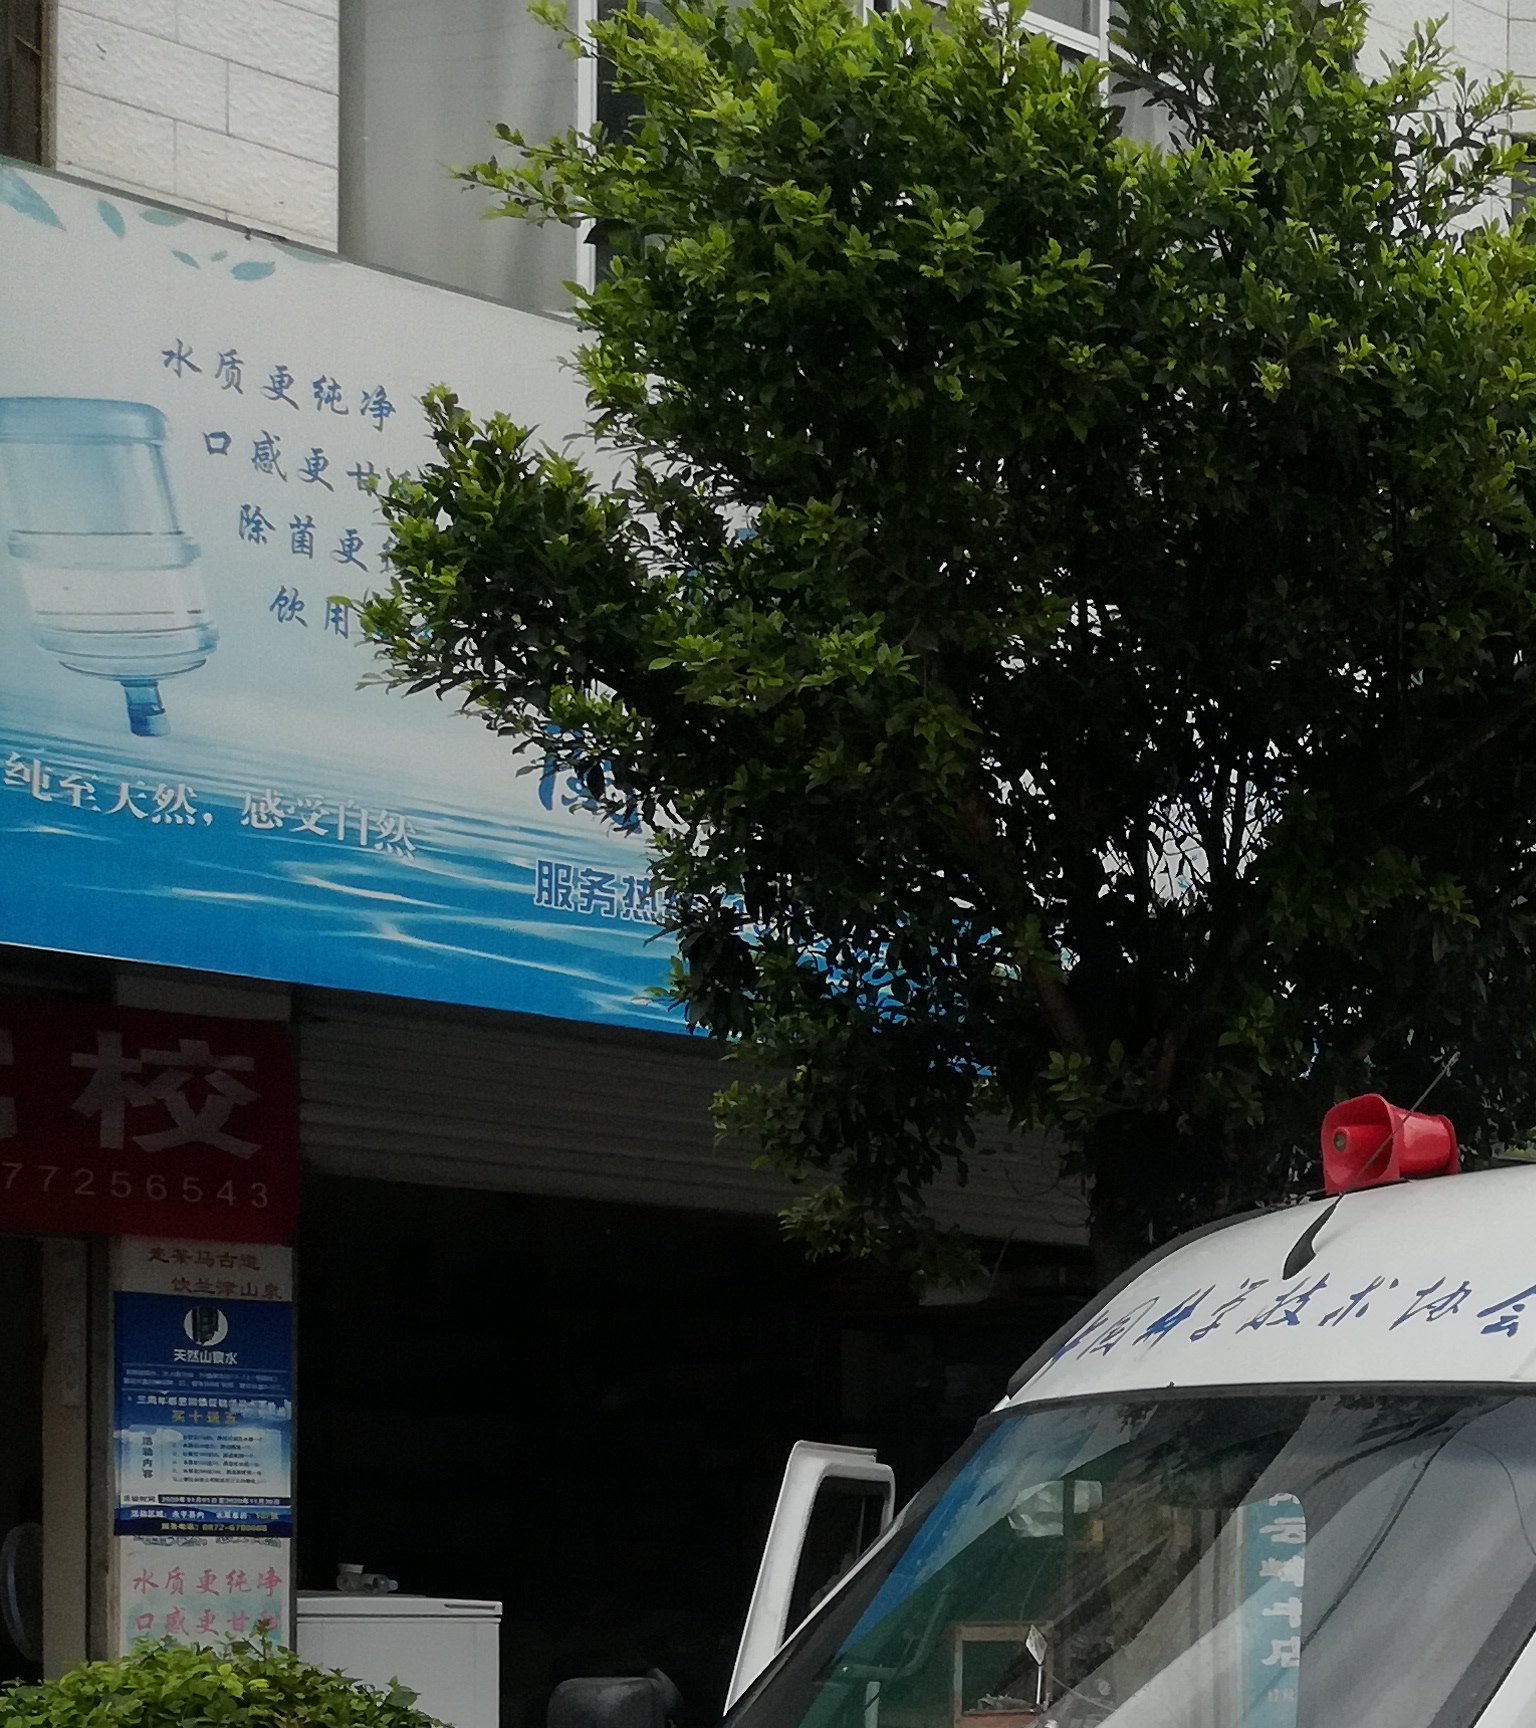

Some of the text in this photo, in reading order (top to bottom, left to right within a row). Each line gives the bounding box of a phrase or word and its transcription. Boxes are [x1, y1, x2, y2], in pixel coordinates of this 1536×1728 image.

[162, 338, 396, 432] 水质更纯净
[536, 860, 702, 926] 服务热
[0, 1029, 263, 1160] 校
[1, 1162, 270, 1209] 77256543
[133, 1566, 283, 1598] 水质更纯净
